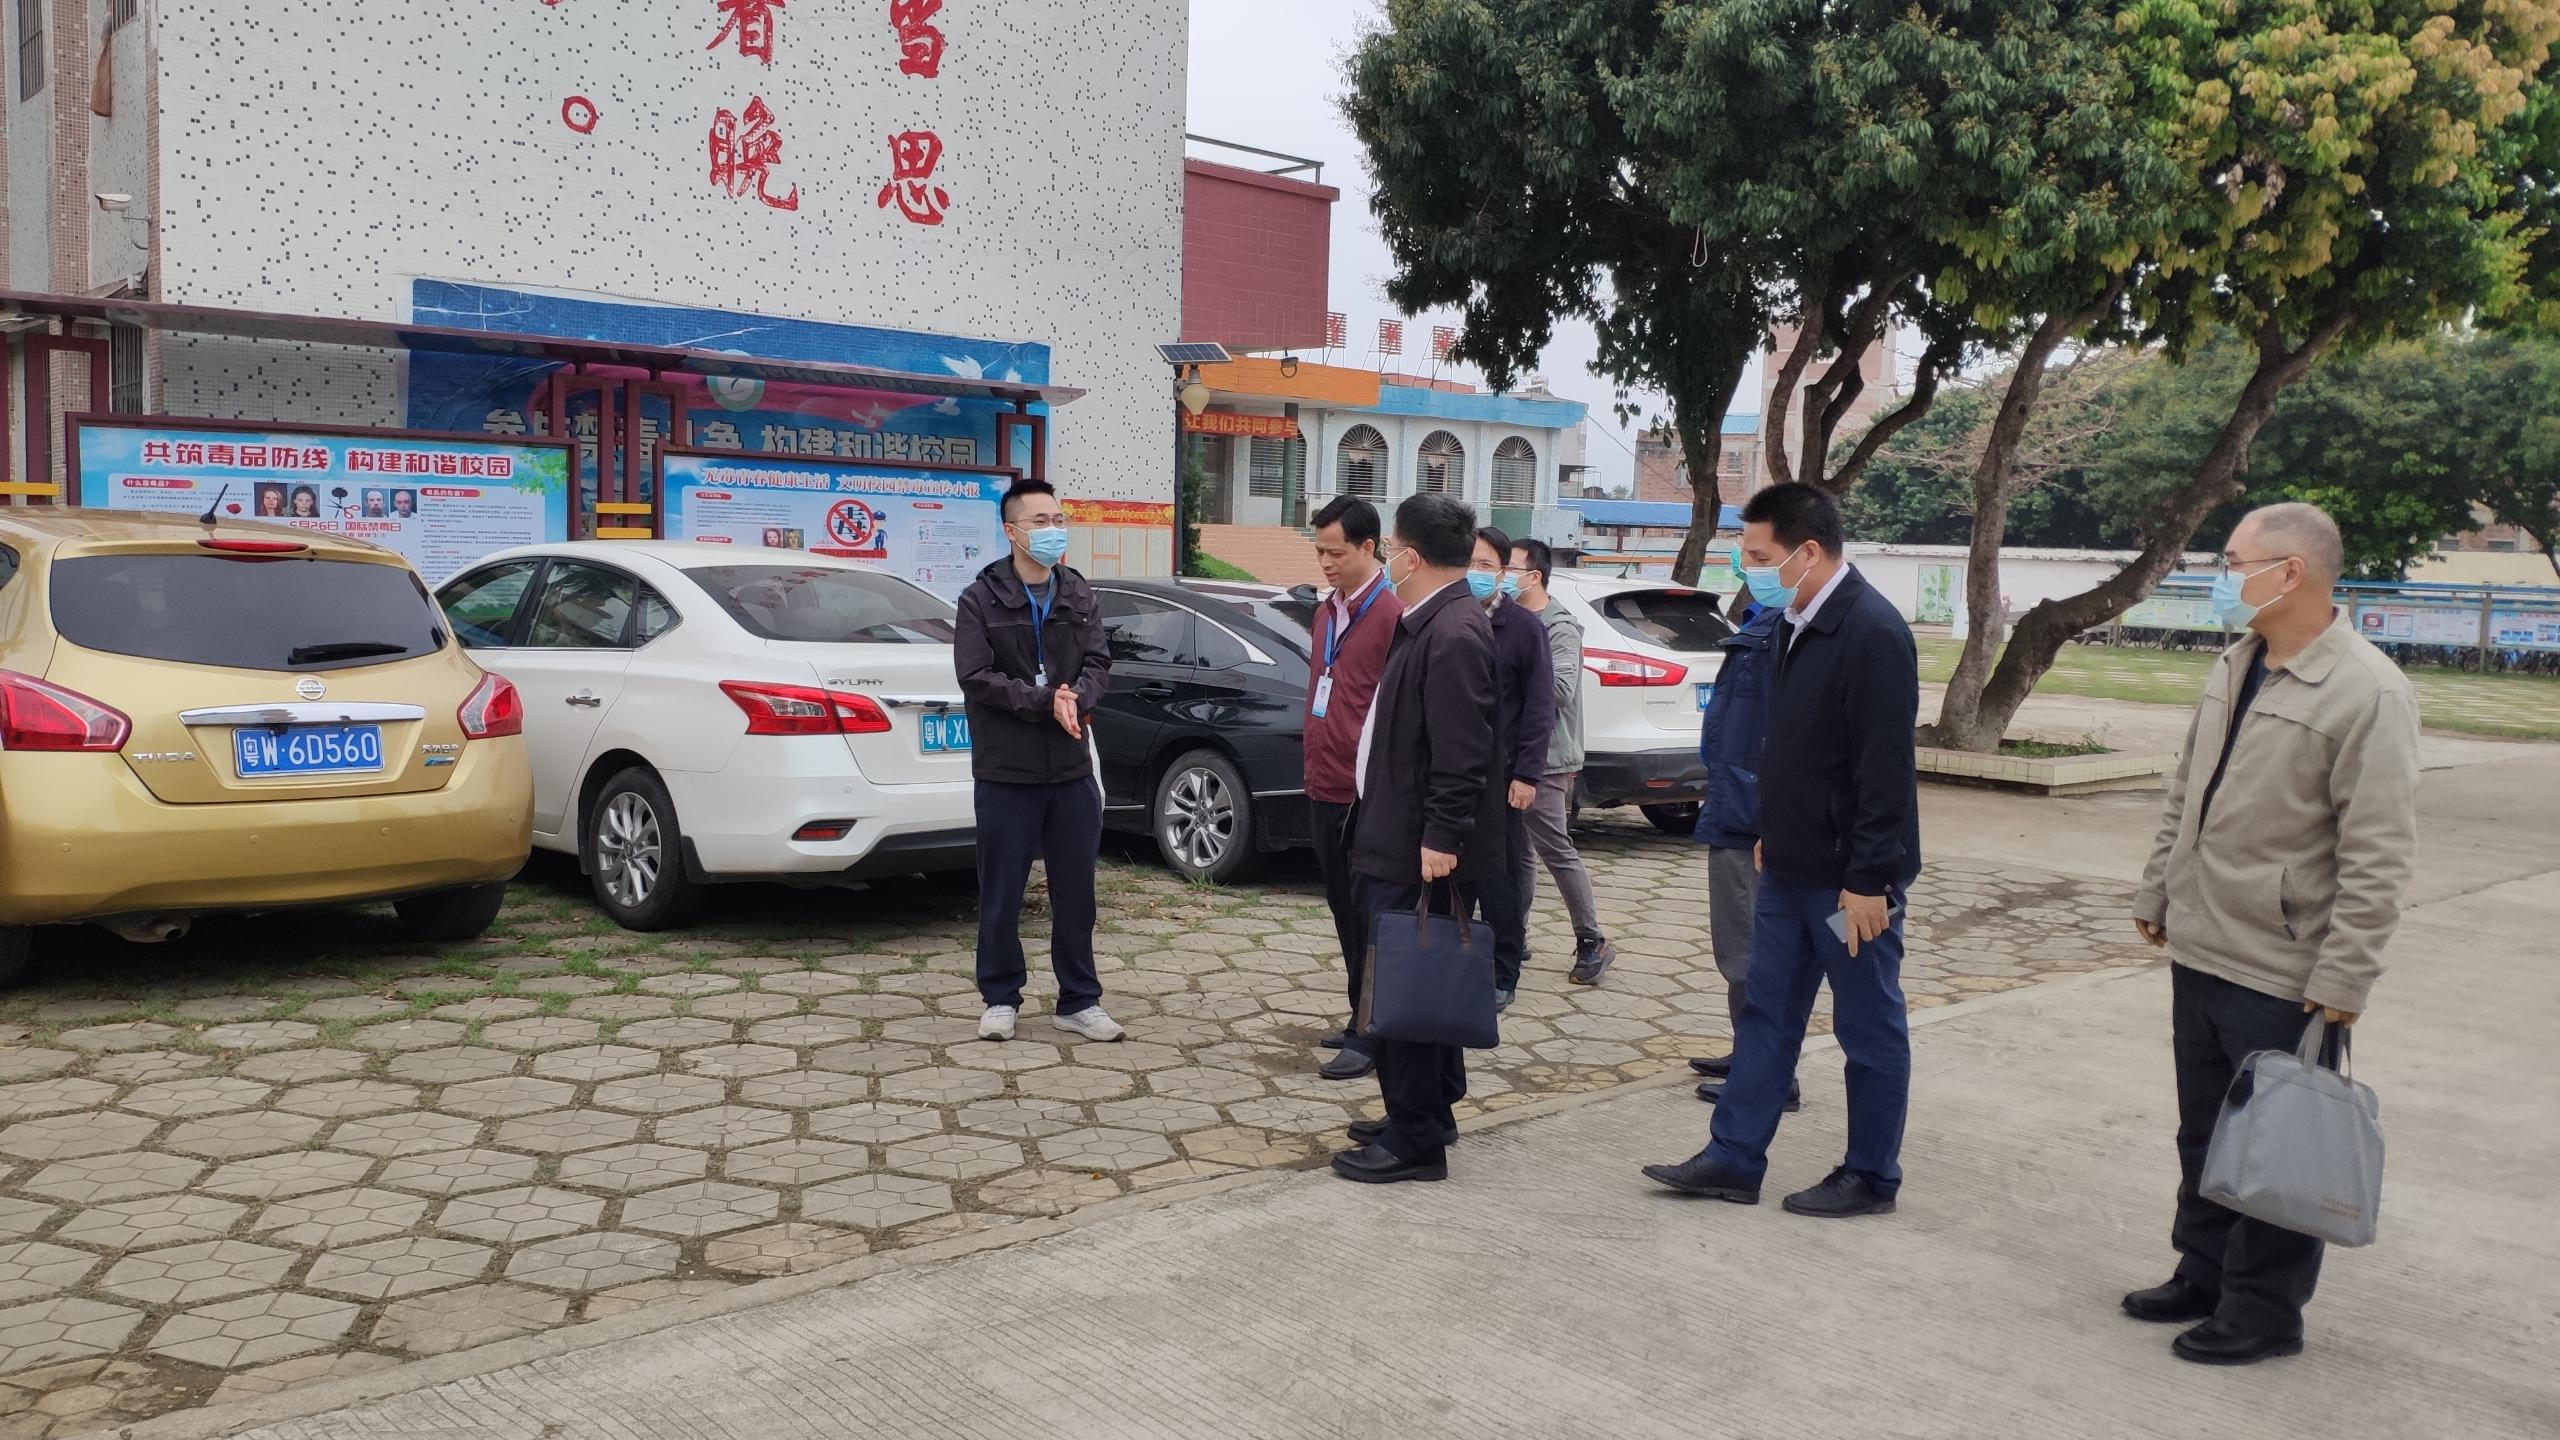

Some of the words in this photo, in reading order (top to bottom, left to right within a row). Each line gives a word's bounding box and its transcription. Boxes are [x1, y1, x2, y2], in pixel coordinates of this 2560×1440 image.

[1183, 413, 1298, 436] 让我们共同参与
[143, 441, 329, 470] 共筑毒品防线
[347, 449, 512, 478] 构建和谐校园
[702, 467, 831, 490] 无毒青春健康生活
[836, 473, 981, 498] 文明校园禁毒宣传小报
[827, 677, 885, 686] SYLPHY
